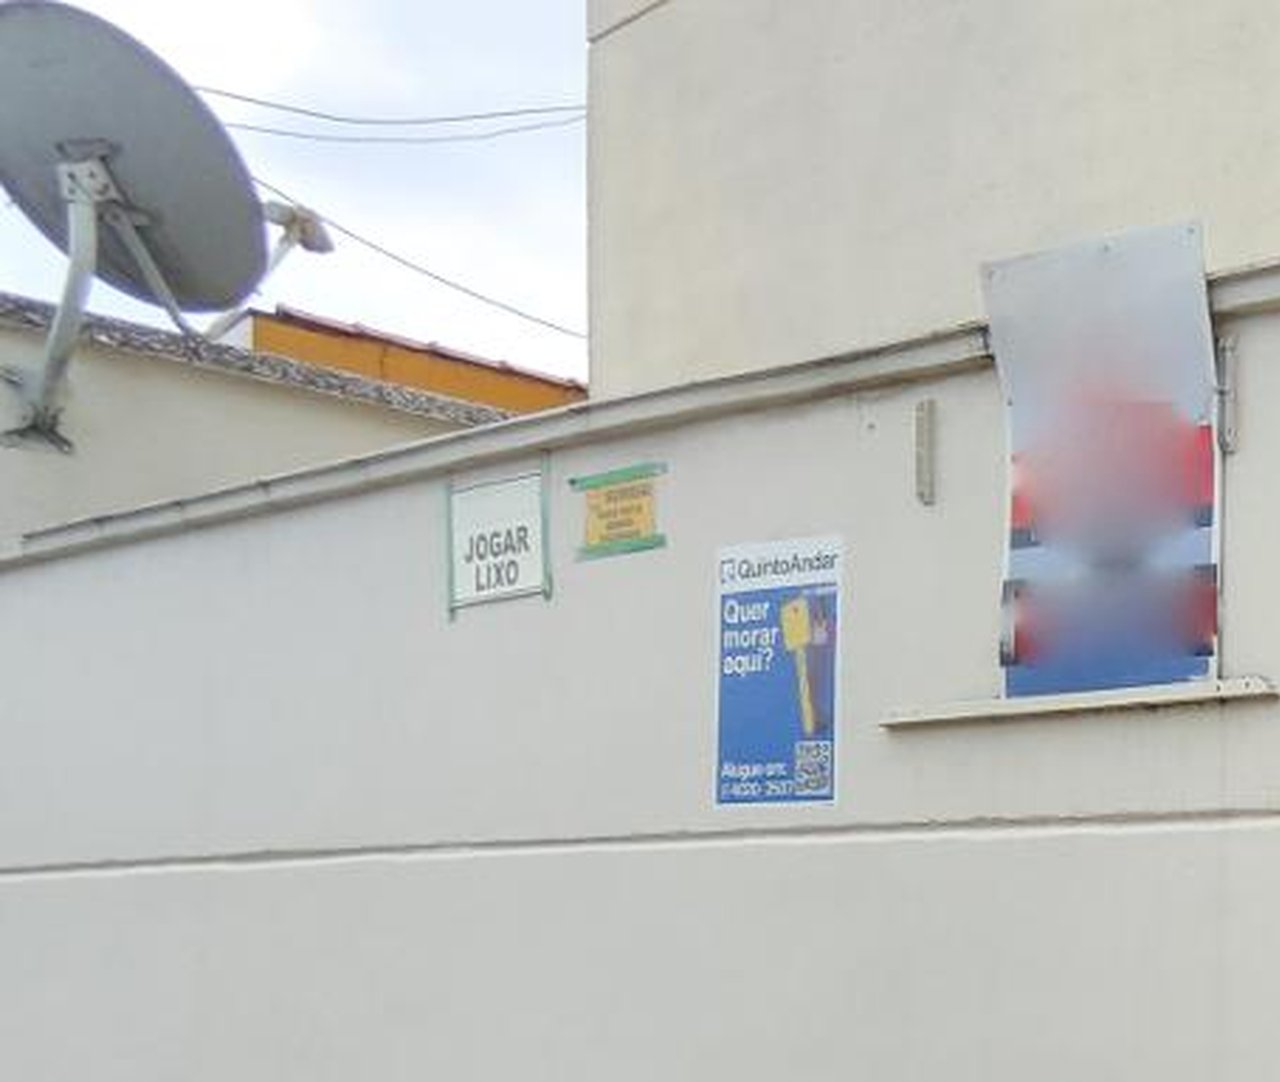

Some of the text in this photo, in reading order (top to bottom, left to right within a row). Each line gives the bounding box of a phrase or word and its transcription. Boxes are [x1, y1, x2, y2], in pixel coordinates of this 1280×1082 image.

[464, 526, 530, 563] JOGAR
[475, 560, 519, 592] LIXO
[739, 552, 838, 579] QuintoAndar
[724, 599, 770, 625] Quer
[723, 626, 779, 650] morar
[723, 647, 774, 678] aqui?
